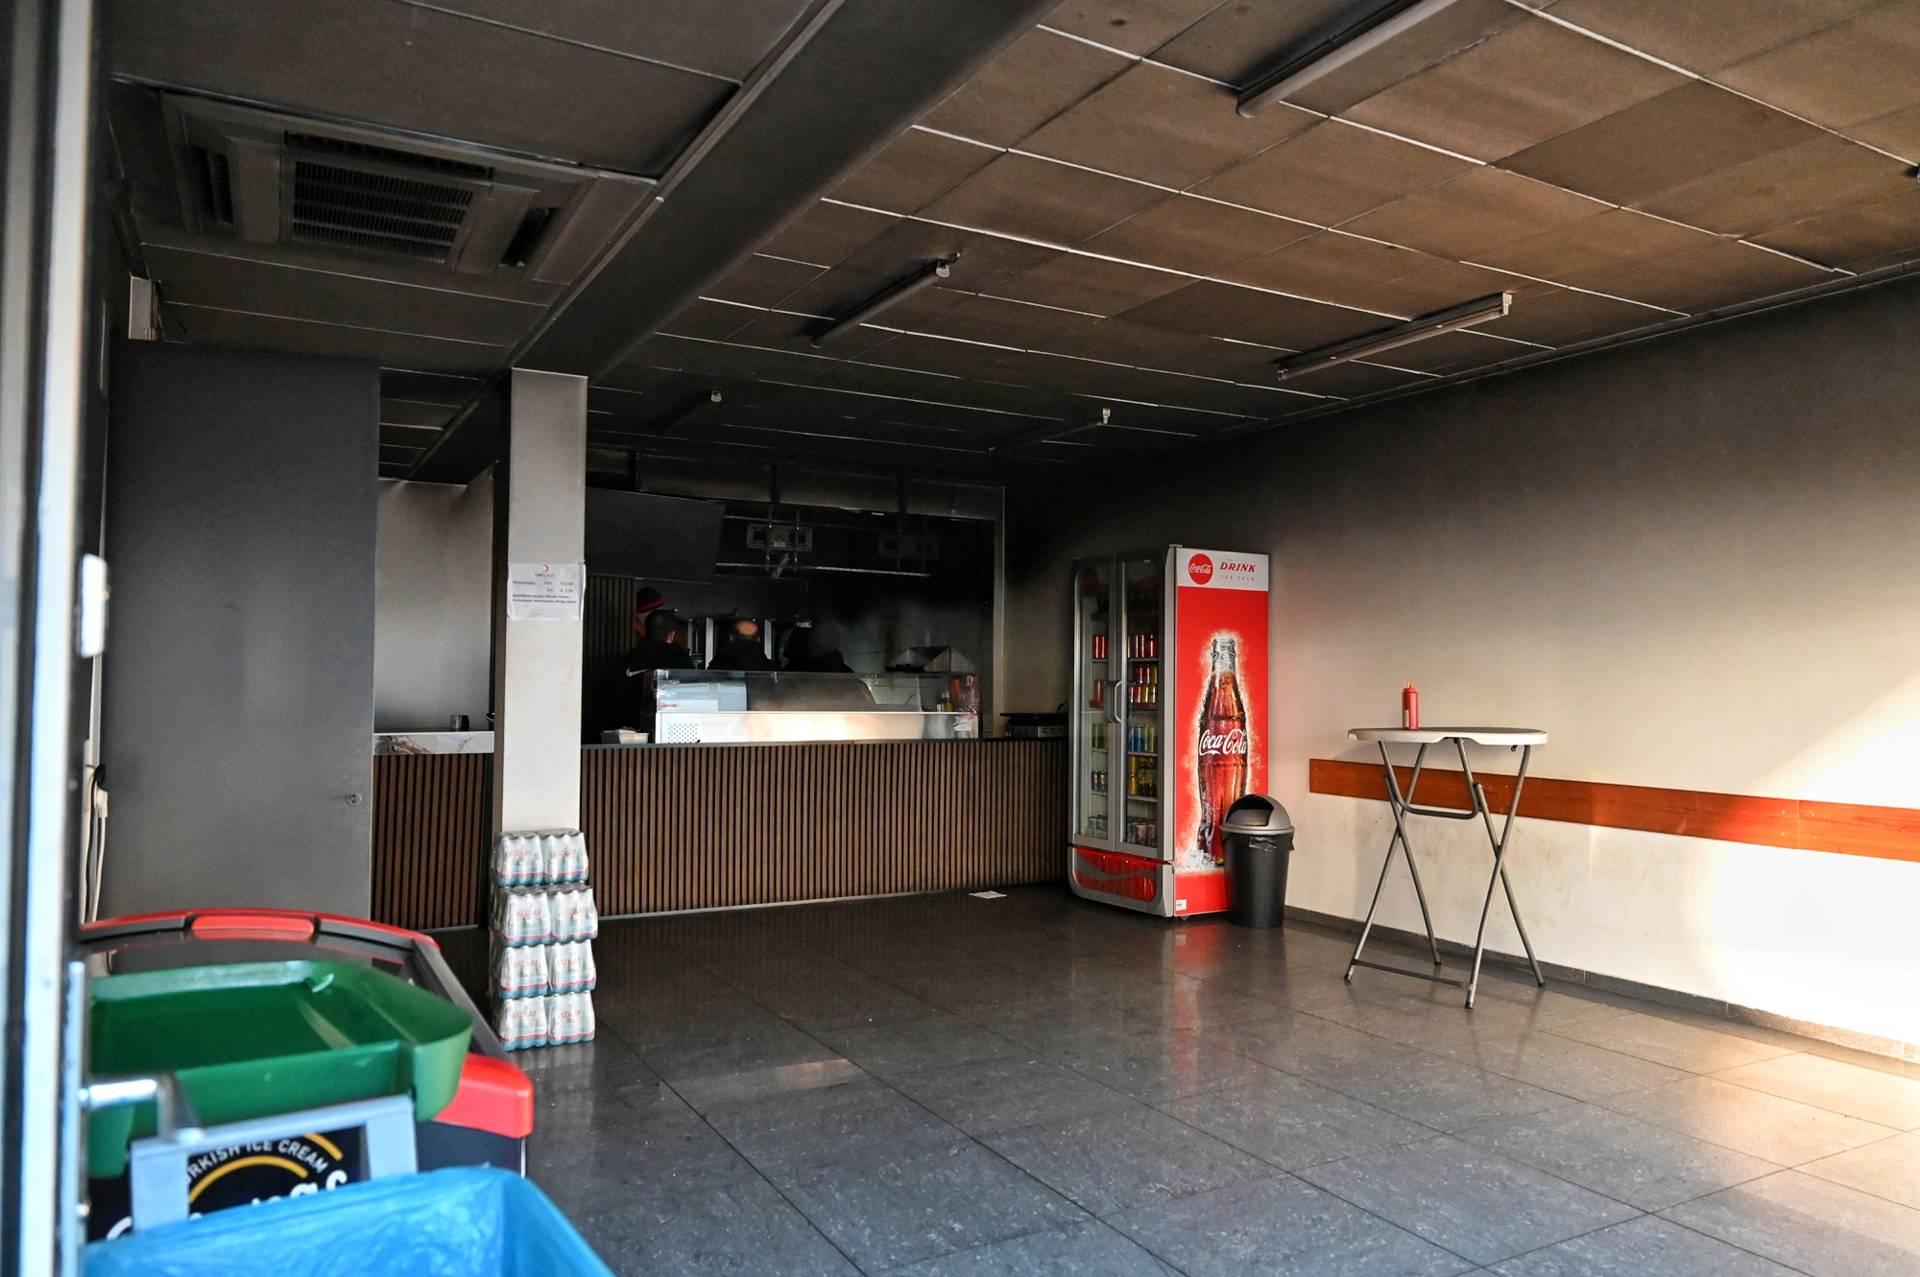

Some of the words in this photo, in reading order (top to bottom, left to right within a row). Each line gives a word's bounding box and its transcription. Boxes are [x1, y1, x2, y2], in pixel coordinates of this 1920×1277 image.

[1219, 561, 1256, 573] DRINK
[1199, 728, 1247, 756] Coca-Cola
[246, 1139, 273, 1153] ICE
[277, 1138, 330, 1174] CREAM
